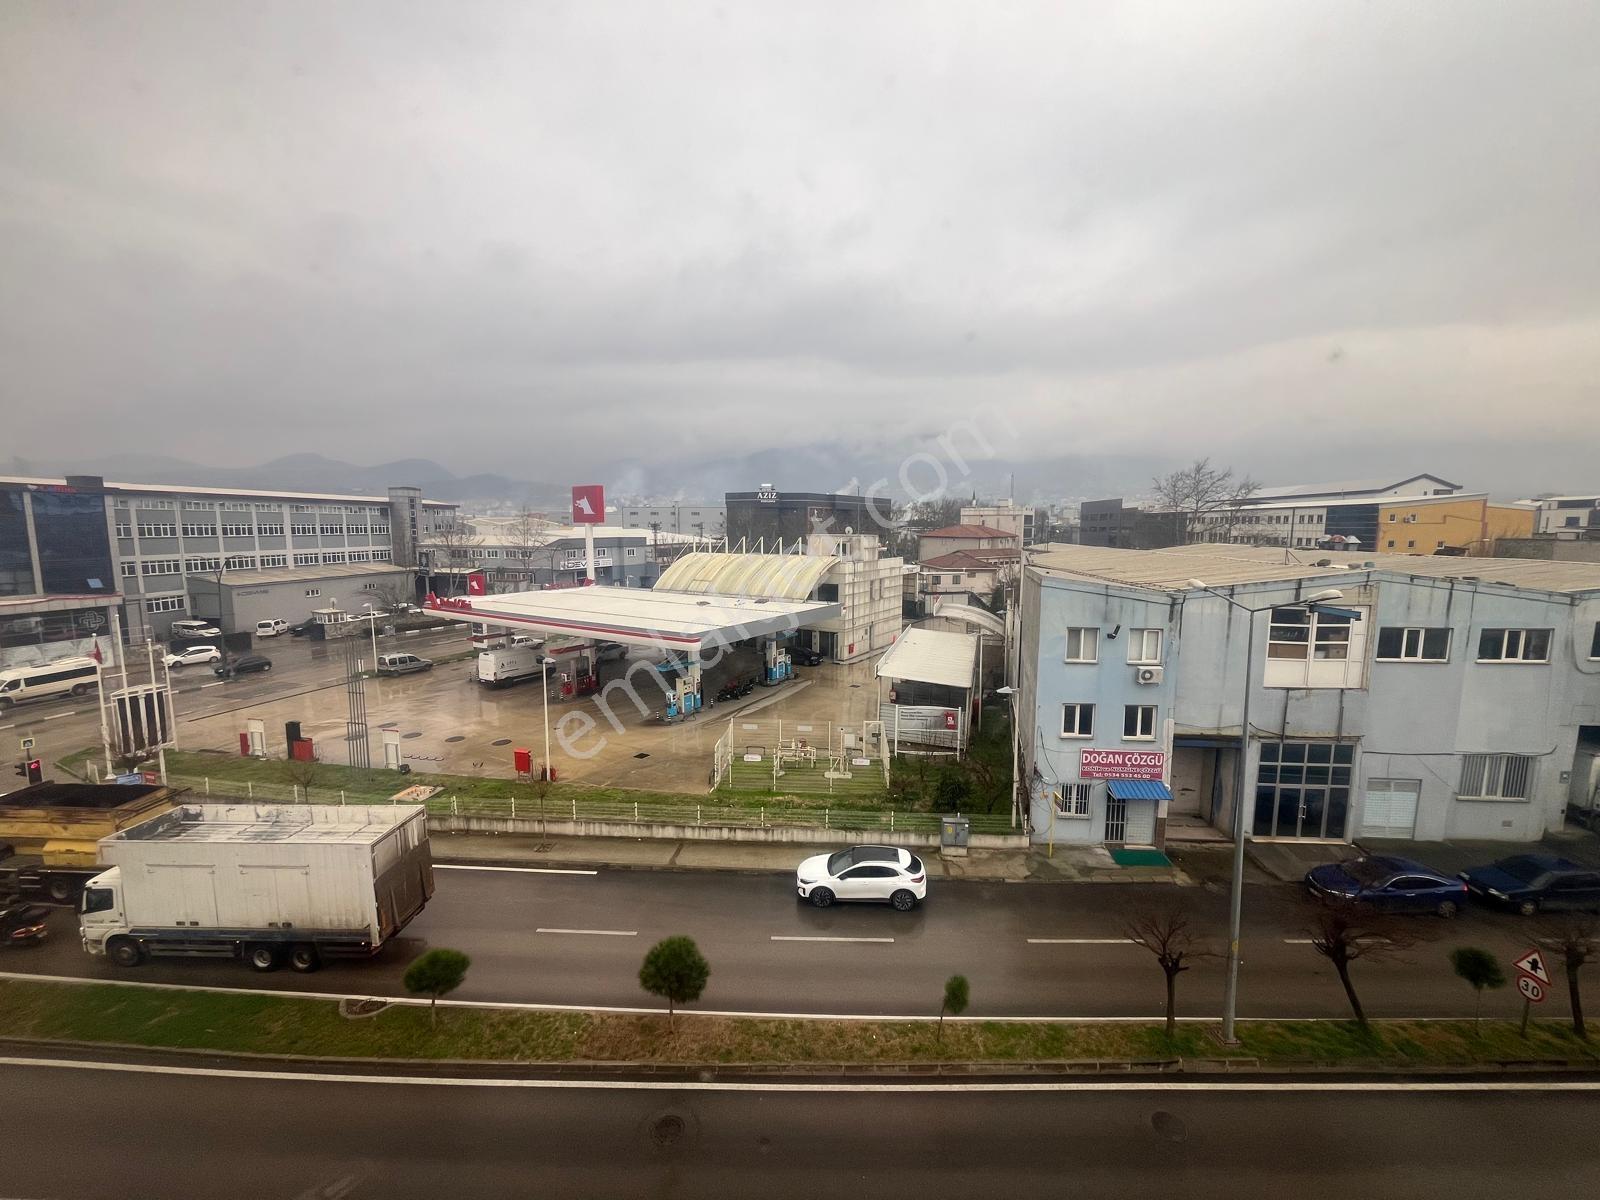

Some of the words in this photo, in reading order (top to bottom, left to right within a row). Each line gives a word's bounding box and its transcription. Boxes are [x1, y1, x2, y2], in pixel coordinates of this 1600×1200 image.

[1082, 752, 1123, 764] DOĞAN
[1125, 753, 1163, 767] ÇÖZGÜ
[1521, 979, 1540, 998] 30
